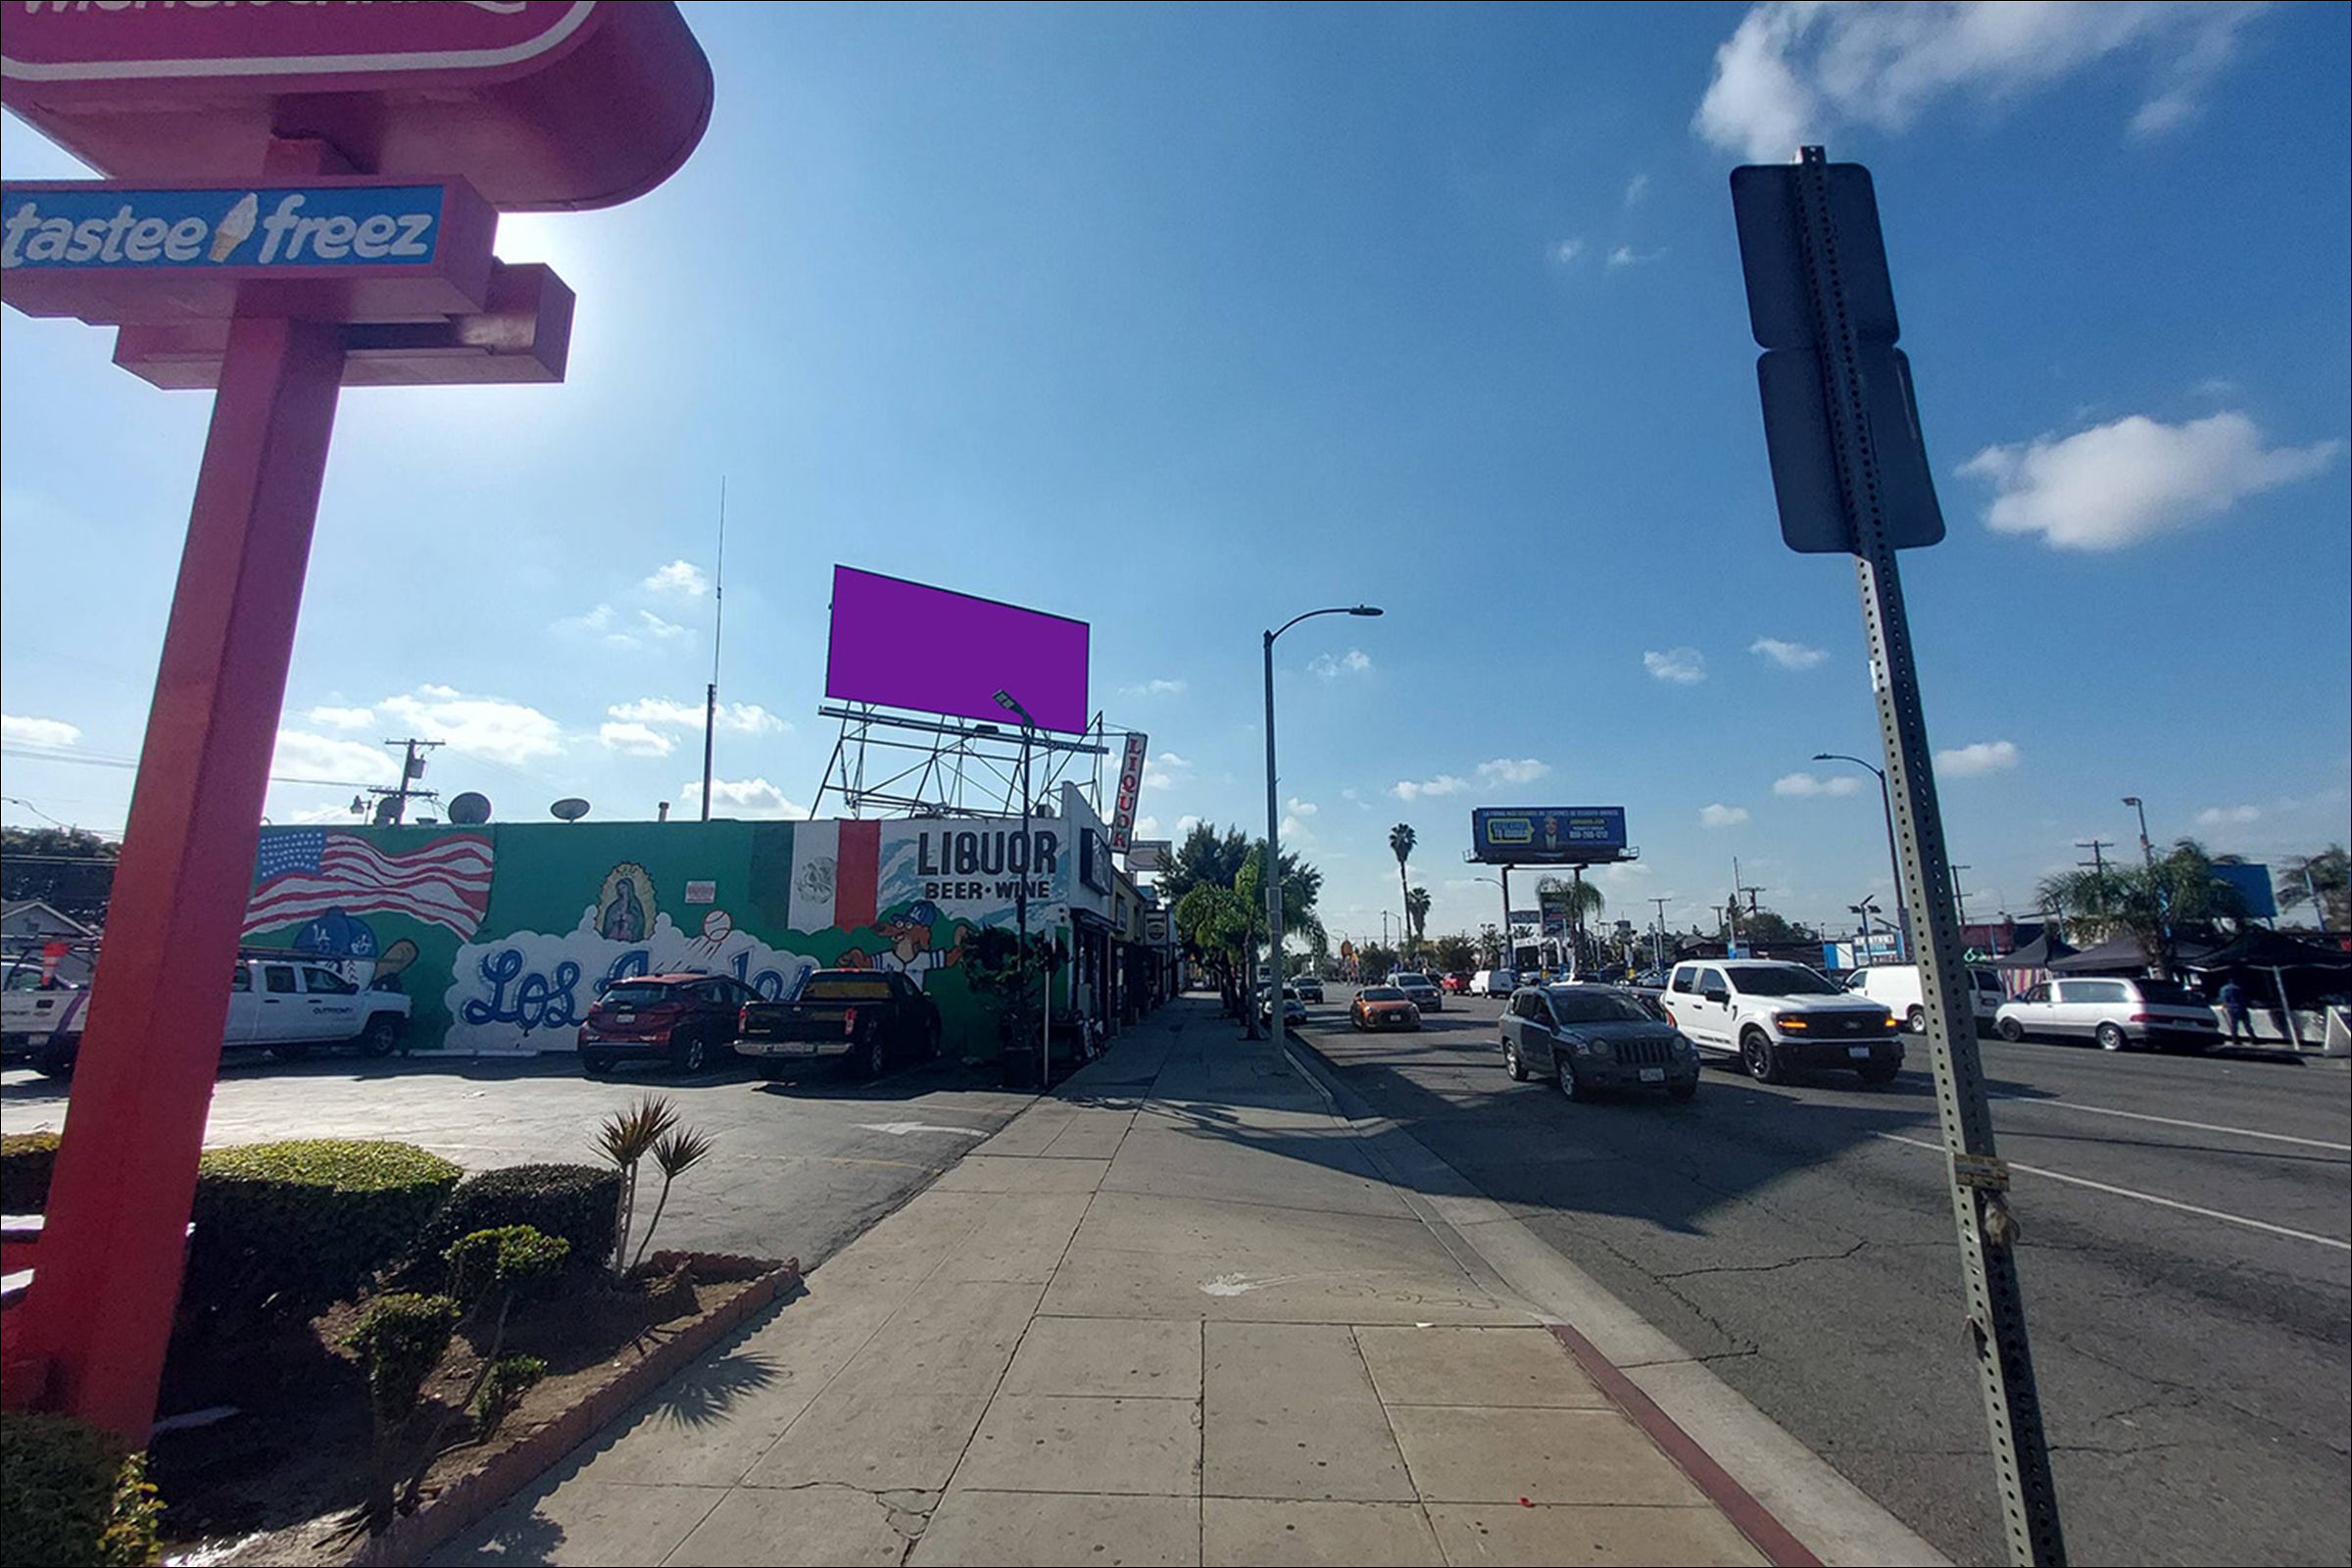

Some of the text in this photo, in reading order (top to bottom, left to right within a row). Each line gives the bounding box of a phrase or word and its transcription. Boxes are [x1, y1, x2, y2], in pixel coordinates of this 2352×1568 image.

[1, 194, 433, 269] tastee freez
[1112, 738, 1143, 850] LIQUOR
[917, 830, 1057, 875] LIQUOR
[925, 881, 1050, 900] BEER WINE
[463, 949, 588, 1029] Los
